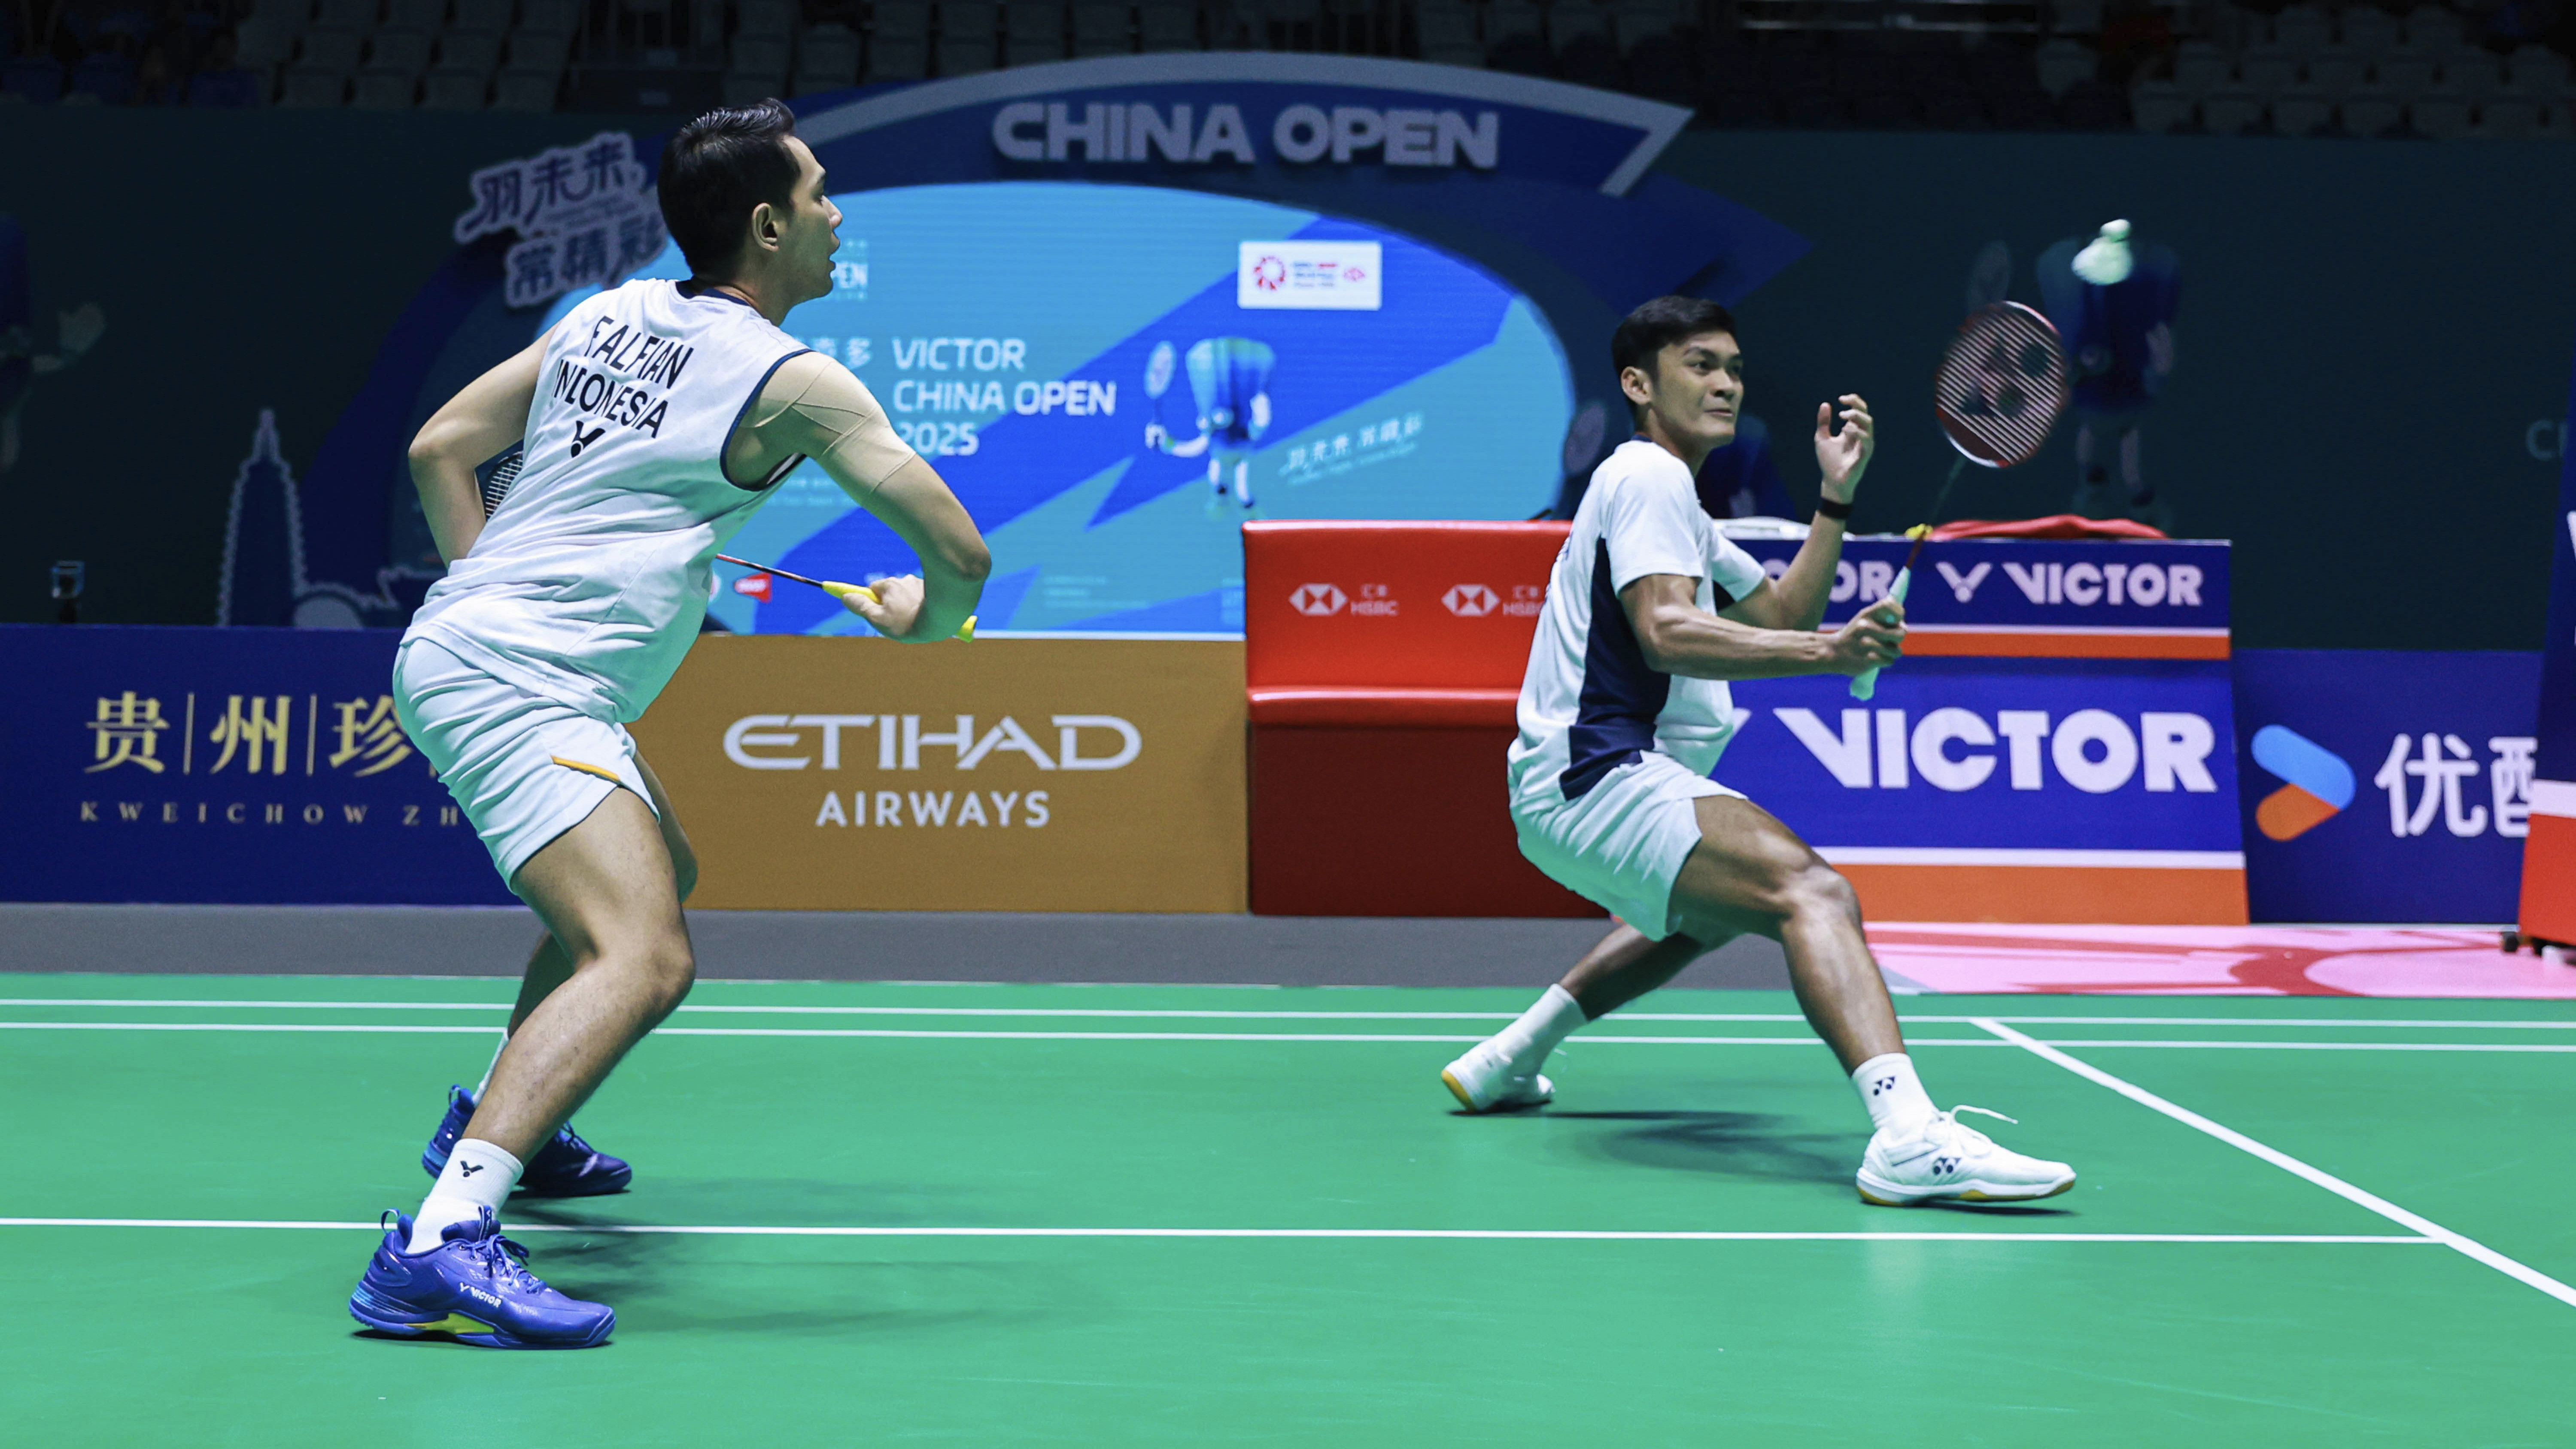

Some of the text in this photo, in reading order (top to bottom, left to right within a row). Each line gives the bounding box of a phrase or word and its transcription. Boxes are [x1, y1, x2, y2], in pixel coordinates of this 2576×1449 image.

[992, 102, 1500, 168] CHINA OPEN
[893, 338, 1026, 371] VICTOR
[893, 380, 1116, 416] CHINA OPEN
[898, 422, 980, 456] 2025
[2003, 562, 2203, 606] VICTOR
[1351, 601, 1398, 616] HSBC
[723, 715, 1142, 770] ETIHAD
[1773, 707, 2217, 793] VICTOR
[80, 802, 459, 826] KWEICHOW ZH
[816, 791, 1050, 827] AIRWAYS
[471, 1287, 502, 1307] VICTOR
